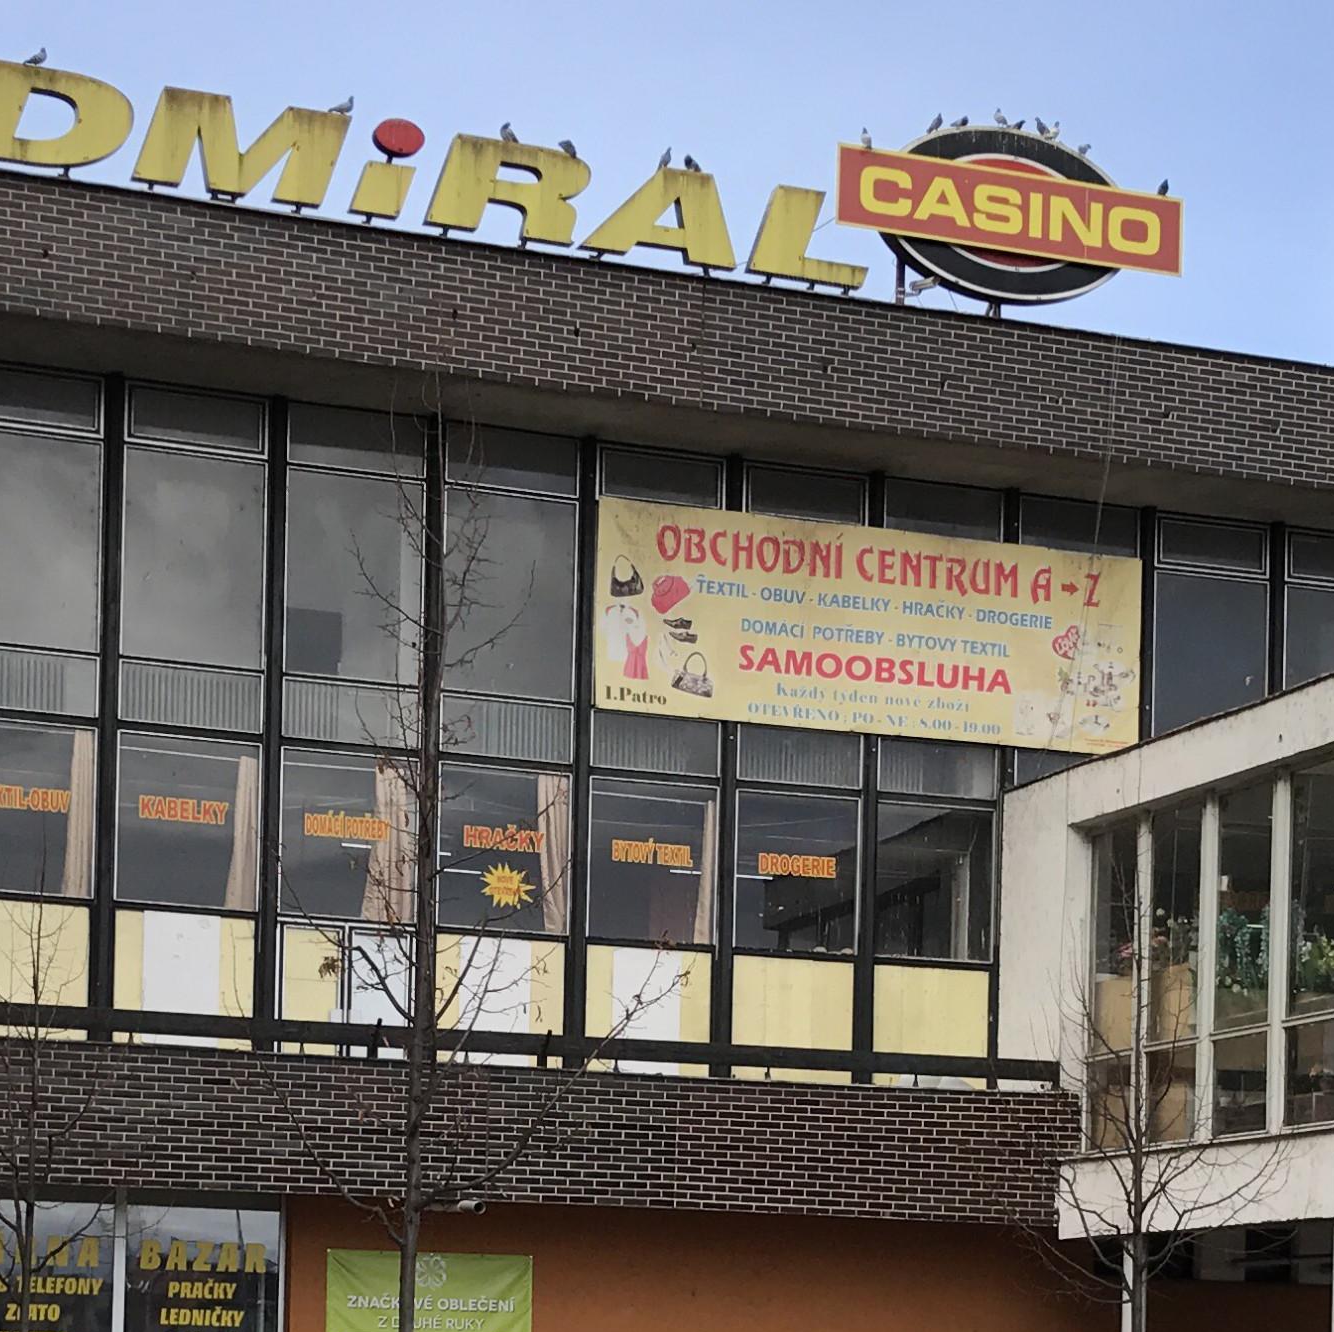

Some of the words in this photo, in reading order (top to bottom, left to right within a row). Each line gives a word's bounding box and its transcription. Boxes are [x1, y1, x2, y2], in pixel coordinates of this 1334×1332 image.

[861, 165, 1162, 256] CASINO
[657, 524, 844, 579] OBCHODNÍ
[856, 545, 1018, 598] CENTRUM
[1030, 565, 1051, 604] A
[760, 587, 805, 604] OBUV
[818, 593, 890, 612] KABELKY
[903, 599, 965, 619] HRAČKY
[976, 609, 1053, 629] DROGERIE
[813, 624, 885, 645] POTŘEBY
[961, 640, 1010, 657] TEXTIL
[739, 645, 1012, 694] SAMOOBSLUHA
[852, 711, 874, 724] PO
[886, 714, 908, 728] NE
[139, 795, 229, 824] KABELKY
[304, 810, 344, 837] DOMÁCÍ
[464, 824, 546, 853] HRAČKY
[612, 838, 654, 864] BYTOVÝ
[656, 843, 694, 867] TEXTIL
[759, 853, 837, 878] DROGERIE
[140, 1239, 267, 1273] BAZAR
[168, 1278, 237, 1299] PRAČKY
[347, 1292, 432, 1310] ZNAČKVÉ
[437, 1294, 516, 1312] OBLEČENÍ
[160, 1306, 245, 1327] LEDNIČKY
[378, 1316, 387, 1328] Z
[446, 1318, 485, 1330] RUKY
